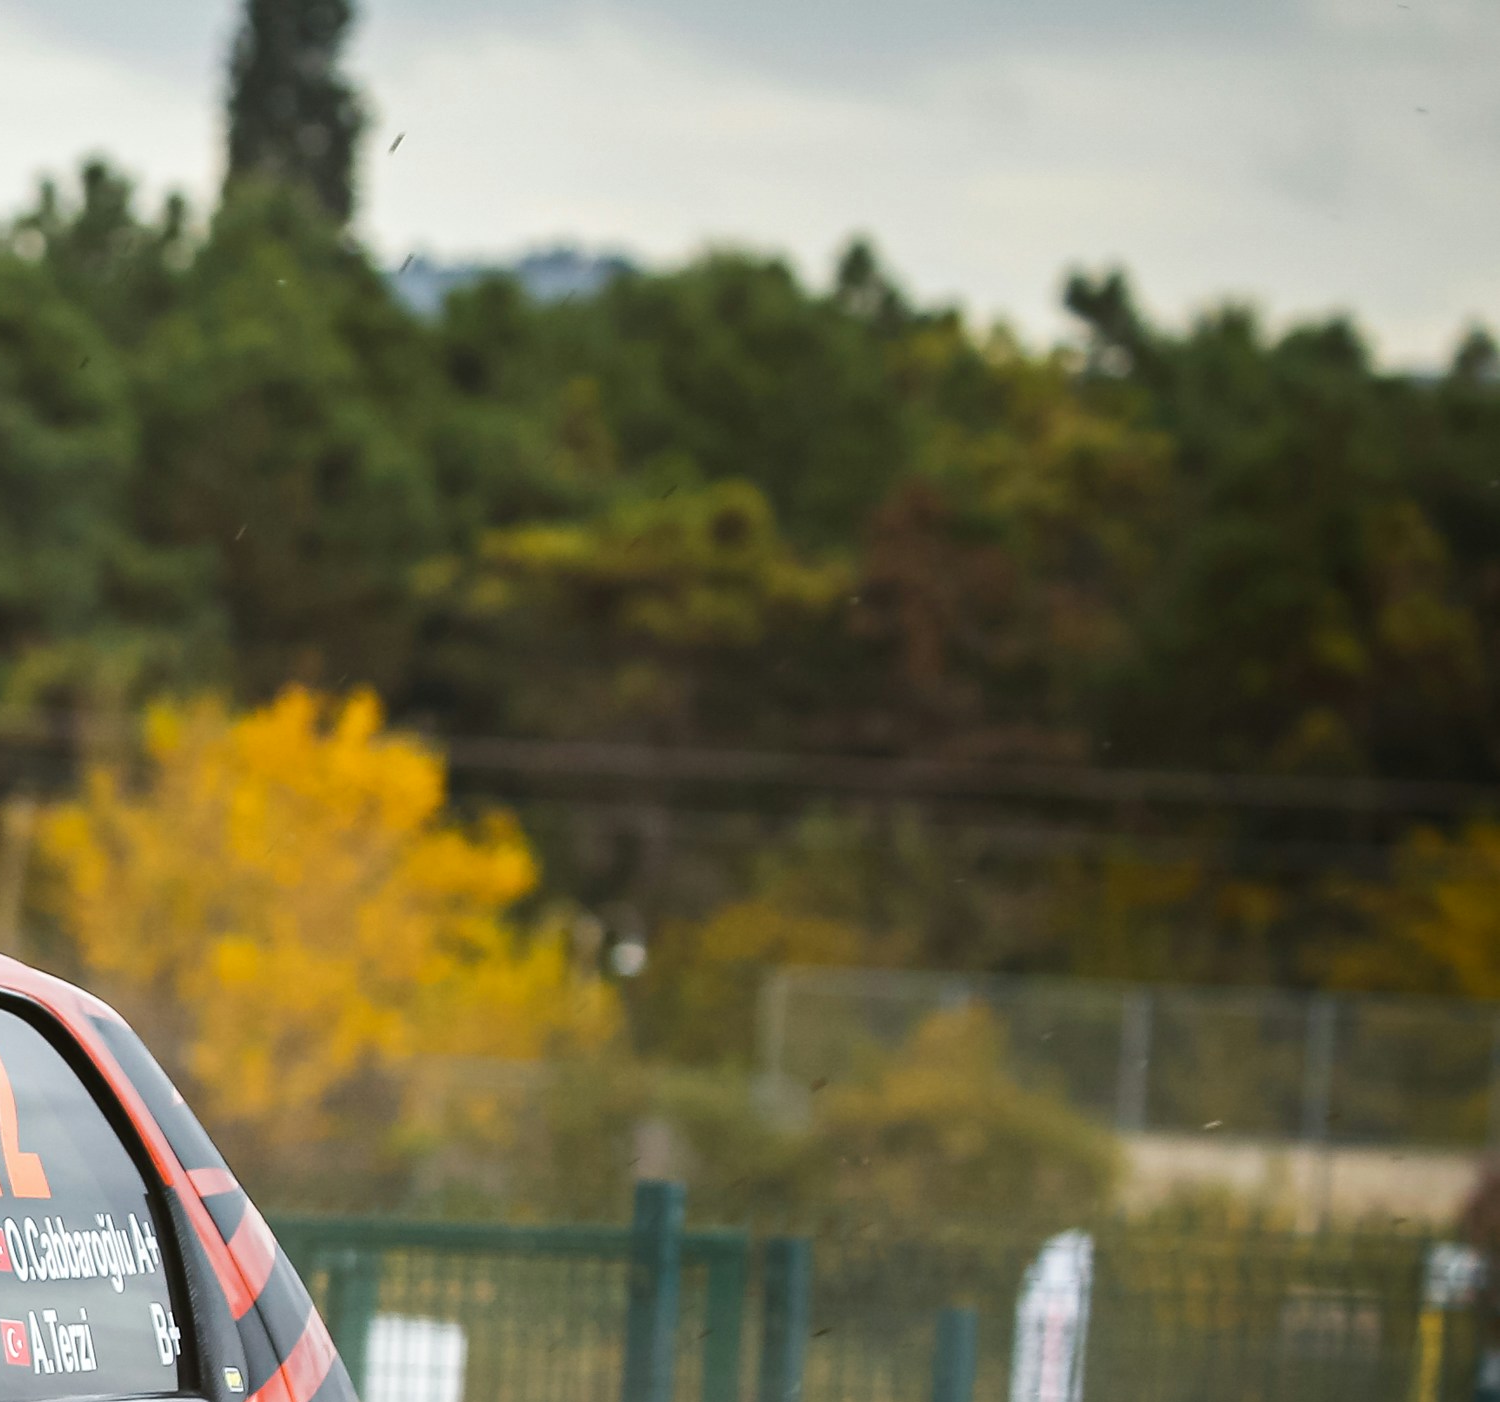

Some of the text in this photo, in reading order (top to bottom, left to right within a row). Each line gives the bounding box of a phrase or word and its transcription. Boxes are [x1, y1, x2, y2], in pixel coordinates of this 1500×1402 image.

[3, 1212, 161, 1294] O.Cabbaroğlu A+
[28, 1301, 181, 1375] A.Terzi B+
